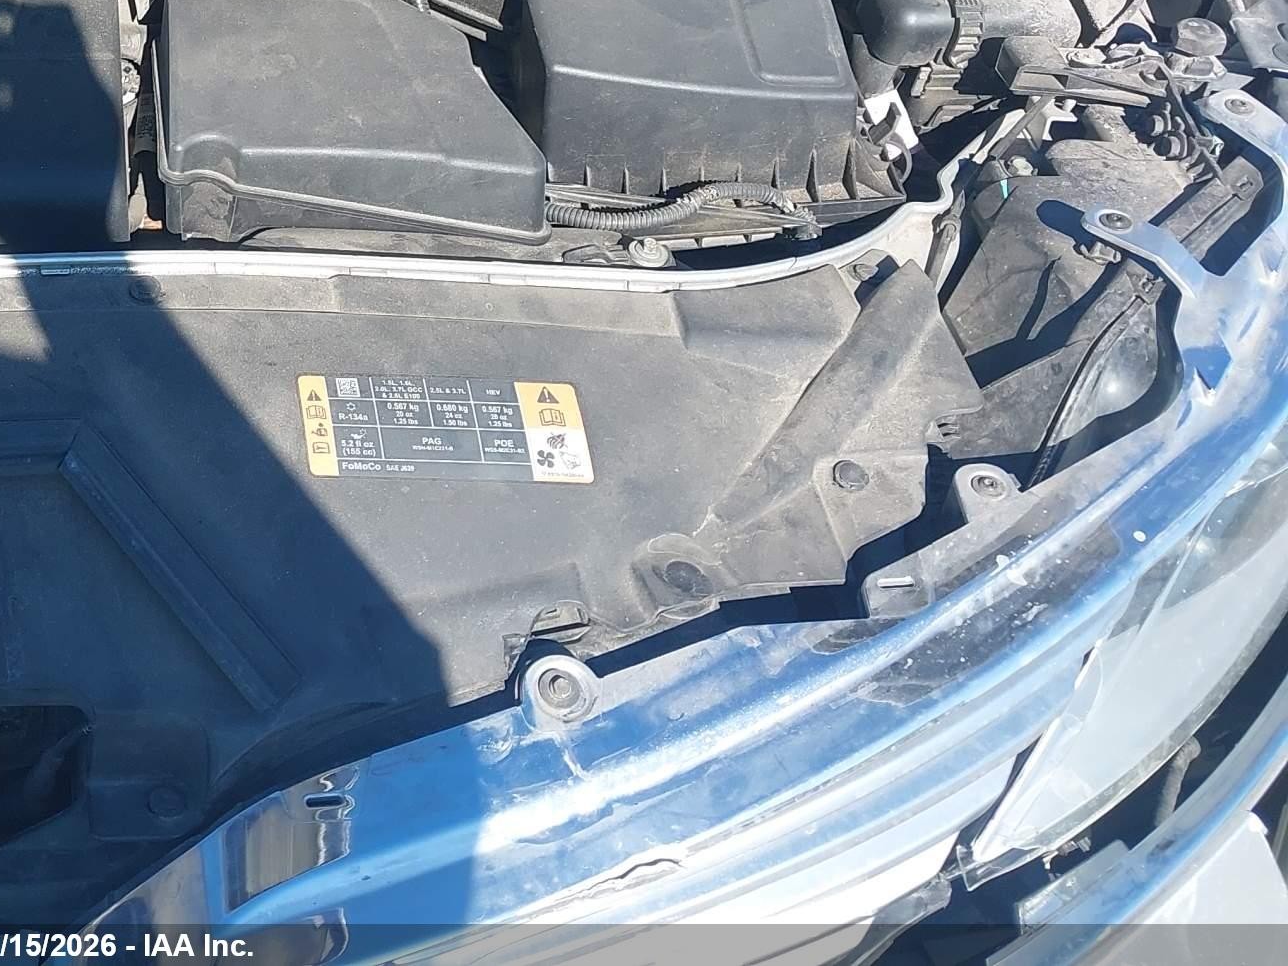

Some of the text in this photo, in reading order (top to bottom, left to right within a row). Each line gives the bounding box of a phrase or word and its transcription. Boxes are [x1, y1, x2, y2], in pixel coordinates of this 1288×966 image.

[387, 402, 419, 412] 0.567 kg
[436, 404, 469, 414] 0.680 kg
[481, 405, 513, 416] 0.567 kg
[338, 413, 368, 421] R-134a
[341, 439, 354, 447] 5.2
[422, 437, 442, 445] PAG
[494, 439, 515, 448] POE
[342, 447, 376, 457] (155 cc)
[342, 462, 381, 471] FoMoCo
